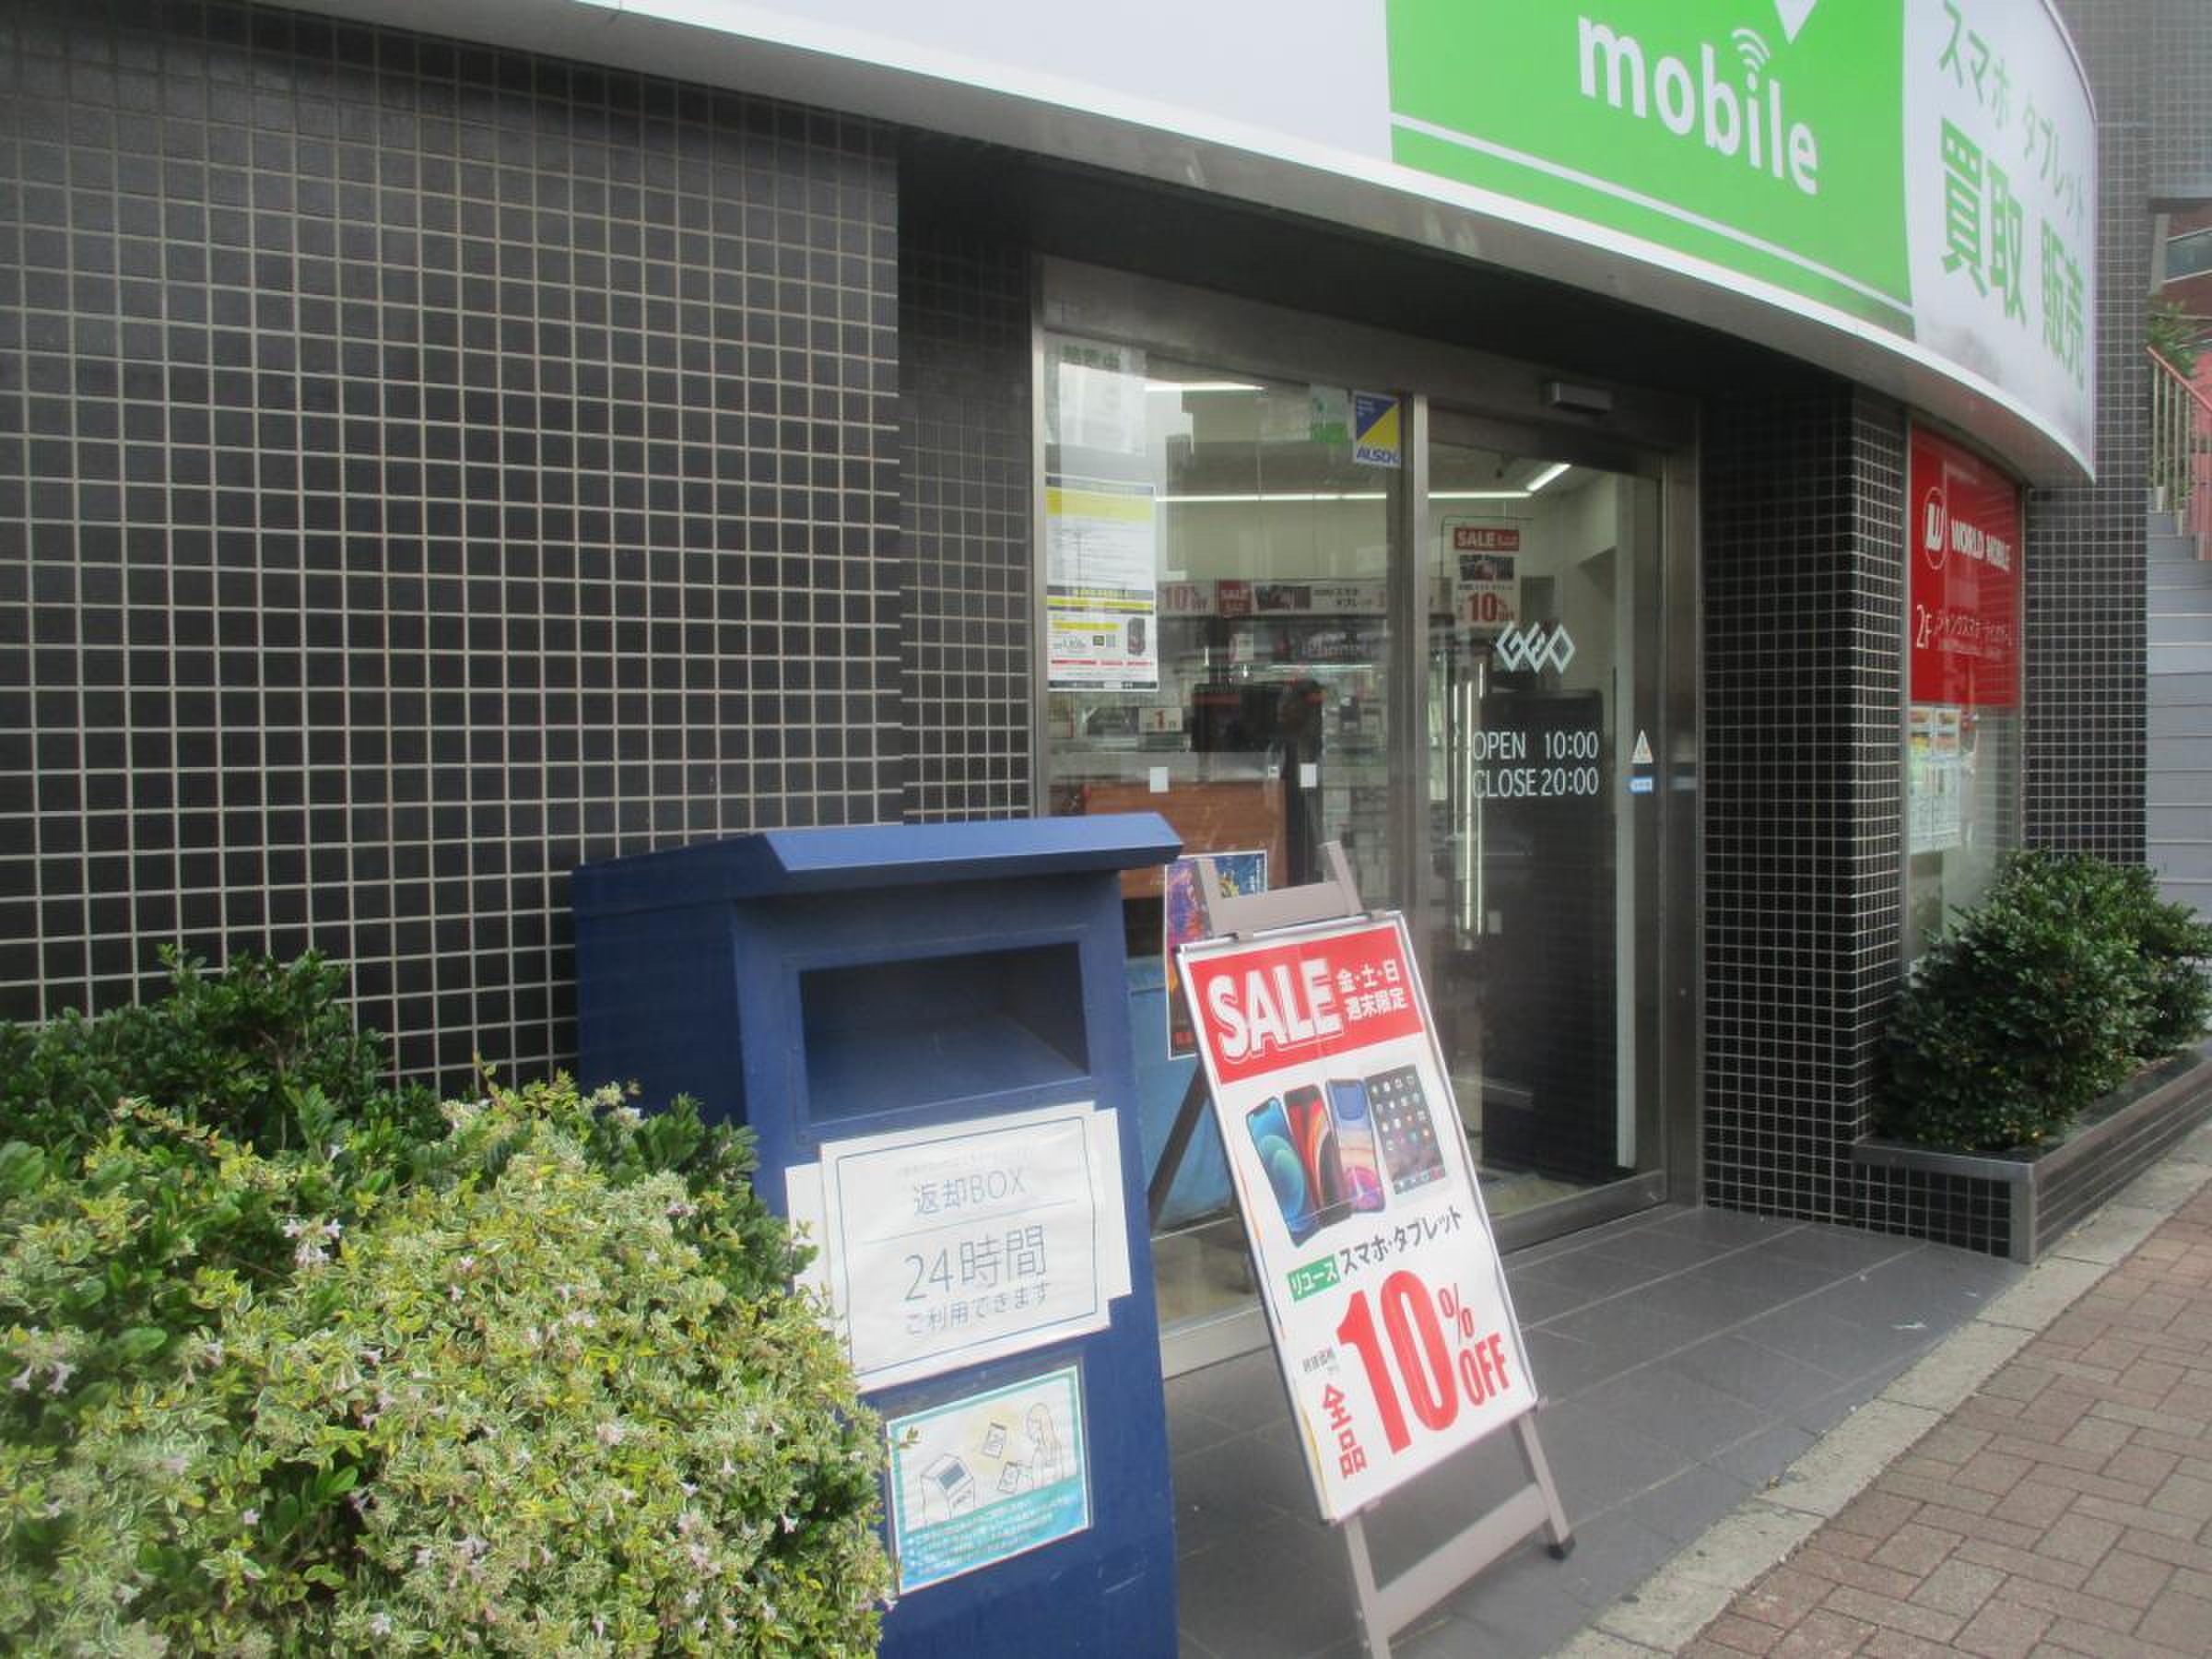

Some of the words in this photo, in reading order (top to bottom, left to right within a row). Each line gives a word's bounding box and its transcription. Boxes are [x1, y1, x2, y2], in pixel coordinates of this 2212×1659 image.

[1938, 0, 2010, 129] スマホ
[1578, 15, 1818, 195] mobile
[1941, 116, 2027, 329] 買取
[2041, 218, 2085, 390] 販売
[1474, 731, 1526, 760] OPEN
[1545, 731, 1599, 760] 10:00
[1474, 768, 1537, 797] CLOSE
[1540, 767, 1599, 796] 20:00
[1206, 958, 1342, 1059] SALE
[1344, 987, 1409, 1021] 週末限定
[912, 1168, 1029, 1216] 返却BOX
[903, 1224, 1047, 1303] 24時間
[905, 1282, 1053, 1335] ご利用できます
[1458, 1333, 1512, 1406] OFF
[1321, 1382, 1368, 1480] 全品
